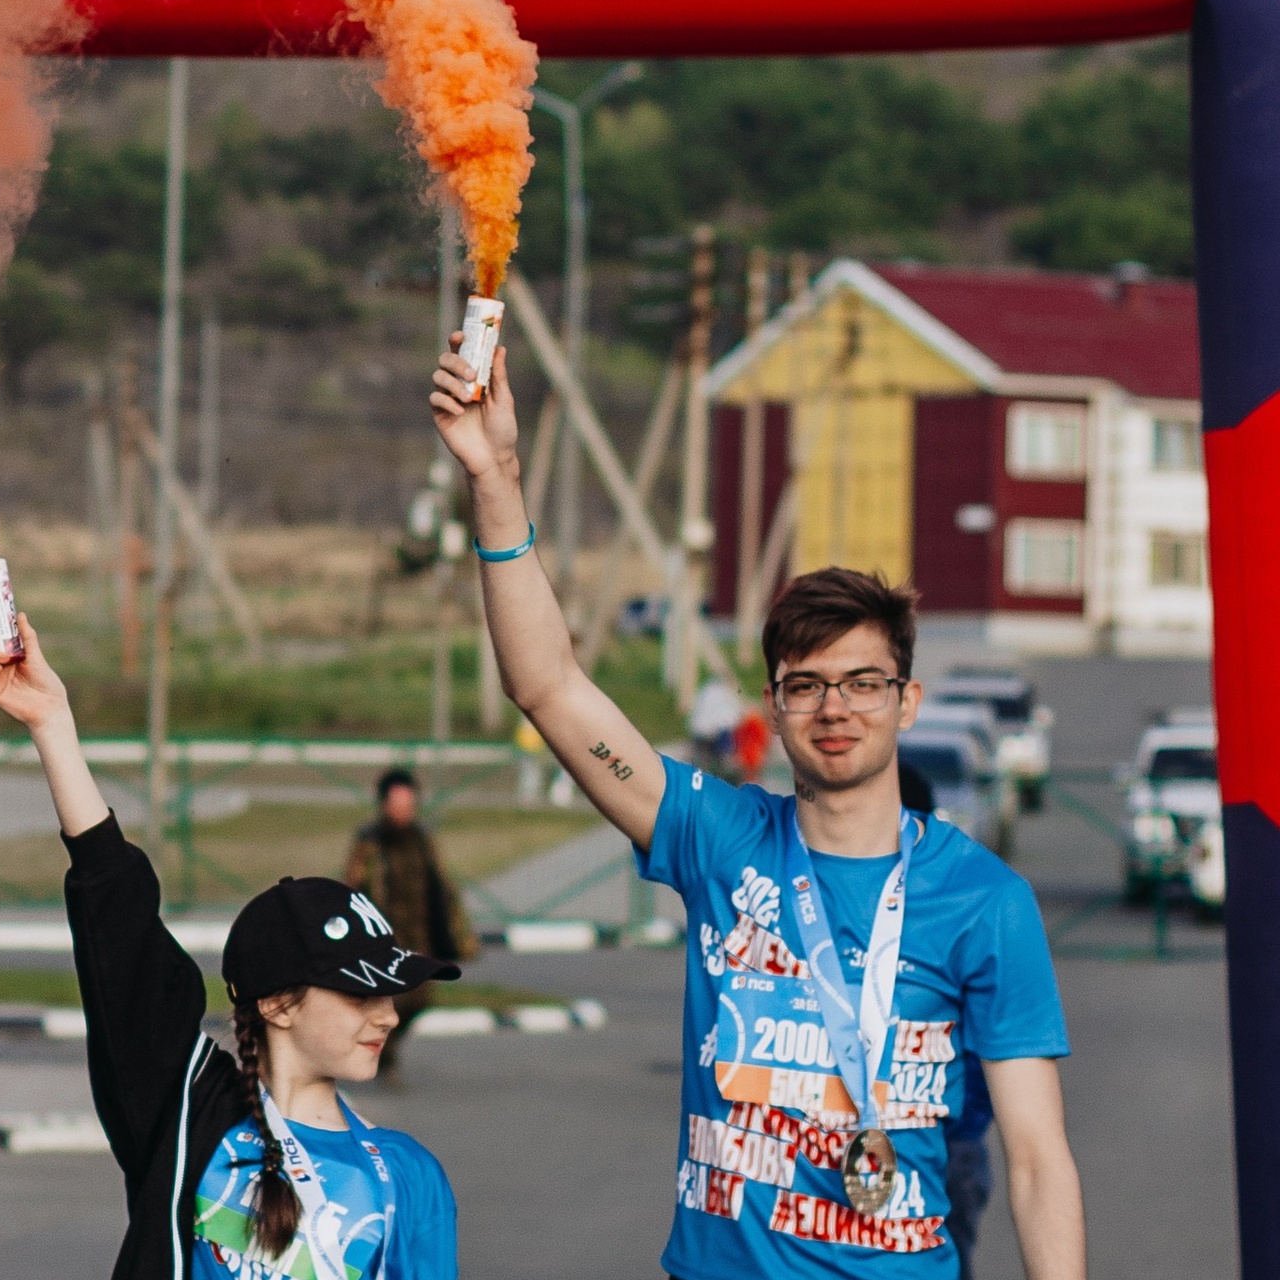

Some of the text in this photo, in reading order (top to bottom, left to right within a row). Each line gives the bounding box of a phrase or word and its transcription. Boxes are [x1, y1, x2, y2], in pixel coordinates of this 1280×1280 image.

[798, 892, 818, 926] ПСБ
[747, 980, 775, 992] ПСБ
[283, 1137, 302, 1166] ПСБ
[371, 1154, 389, 1182] ПСБ
